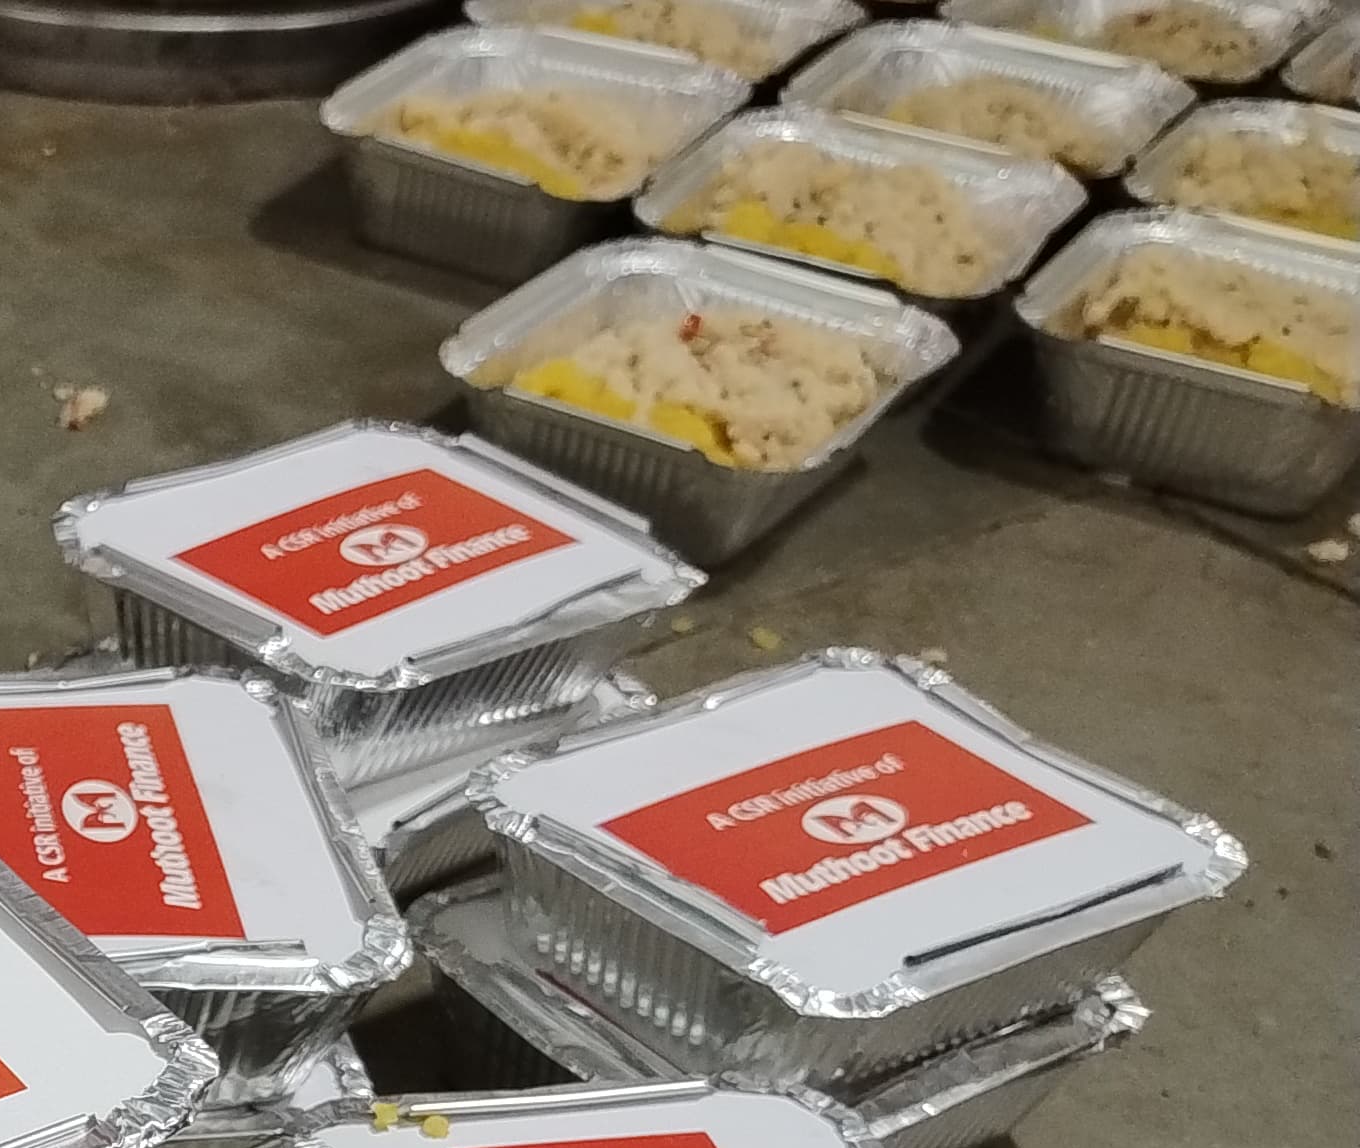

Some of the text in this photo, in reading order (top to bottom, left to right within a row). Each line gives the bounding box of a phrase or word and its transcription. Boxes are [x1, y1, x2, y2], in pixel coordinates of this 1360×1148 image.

[260, 491, 425, 560] A CSR initiative of
[309, 524, 532, 615] Muthoot Finance
[9, 747, 72, 883] A CSR initiative of
[117, 722, 203, 910] Muthoot Finance
[705, 752, 907, 831] A CSR initiative of
[759, 801, 1033, 905] Muthoot Finance
